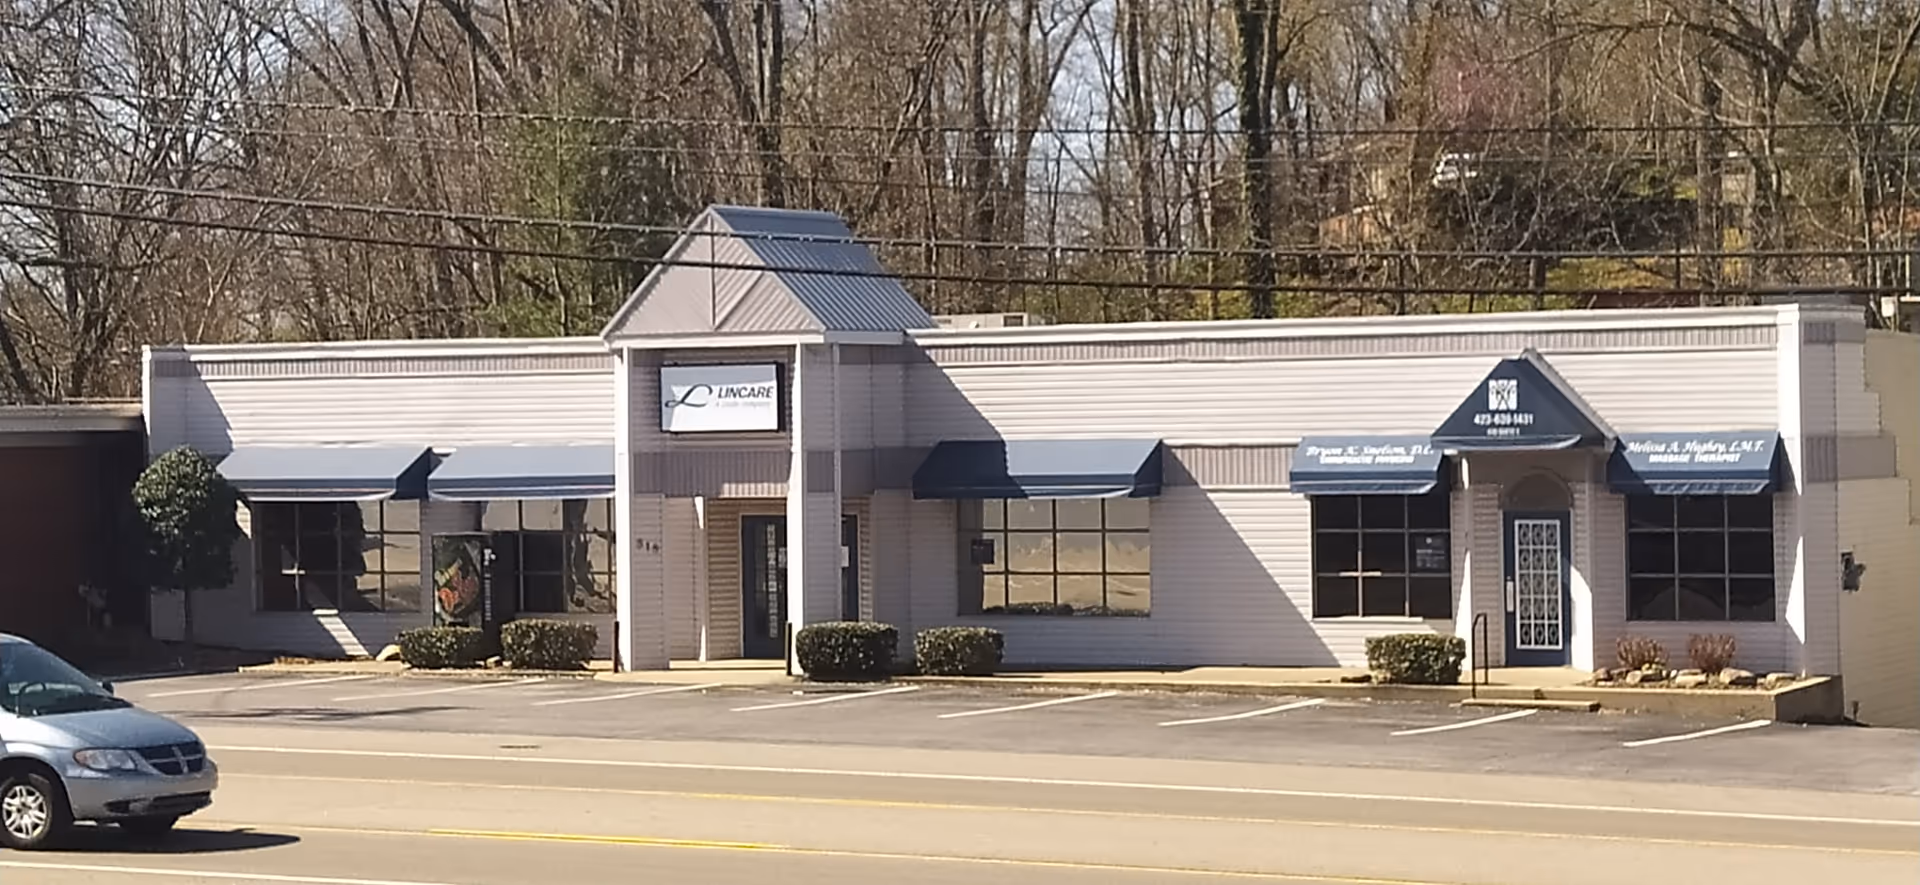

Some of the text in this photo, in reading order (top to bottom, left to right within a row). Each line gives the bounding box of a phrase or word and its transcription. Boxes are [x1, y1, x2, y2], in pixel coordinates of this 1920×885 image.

[717, 386, 774, 399] LINCARE
[1627, 440, 1667, 453] Melissa
[1648, 452, 1741, 464] MASSAGE THERAPIST
